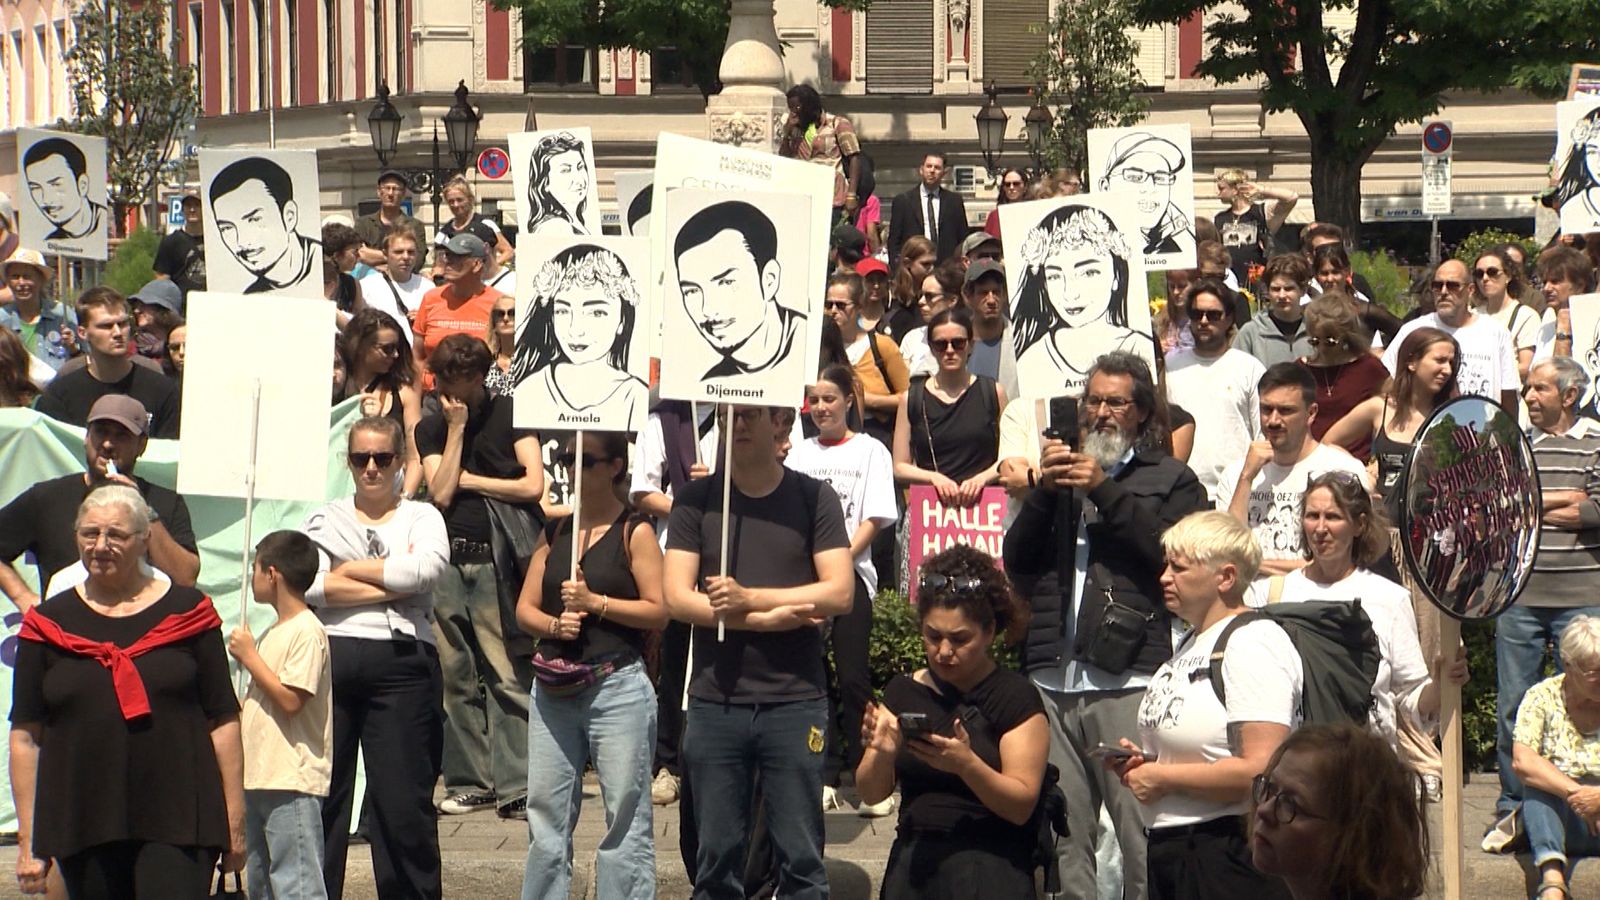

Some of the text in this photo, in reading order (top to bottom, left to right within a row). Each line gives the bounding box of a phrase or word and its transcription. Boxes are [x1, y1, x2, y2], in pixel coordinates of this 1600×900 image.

[1144, 257, 1167, 265] liano
[1065, 378, 1086, 388] Arm
[706, 384, 764, 398] Dijamant
[558, 412, 601, 423] Armela
[1277, 492, 1292, 501] OEZ
[923, 499, 1002, 531] HALLE
